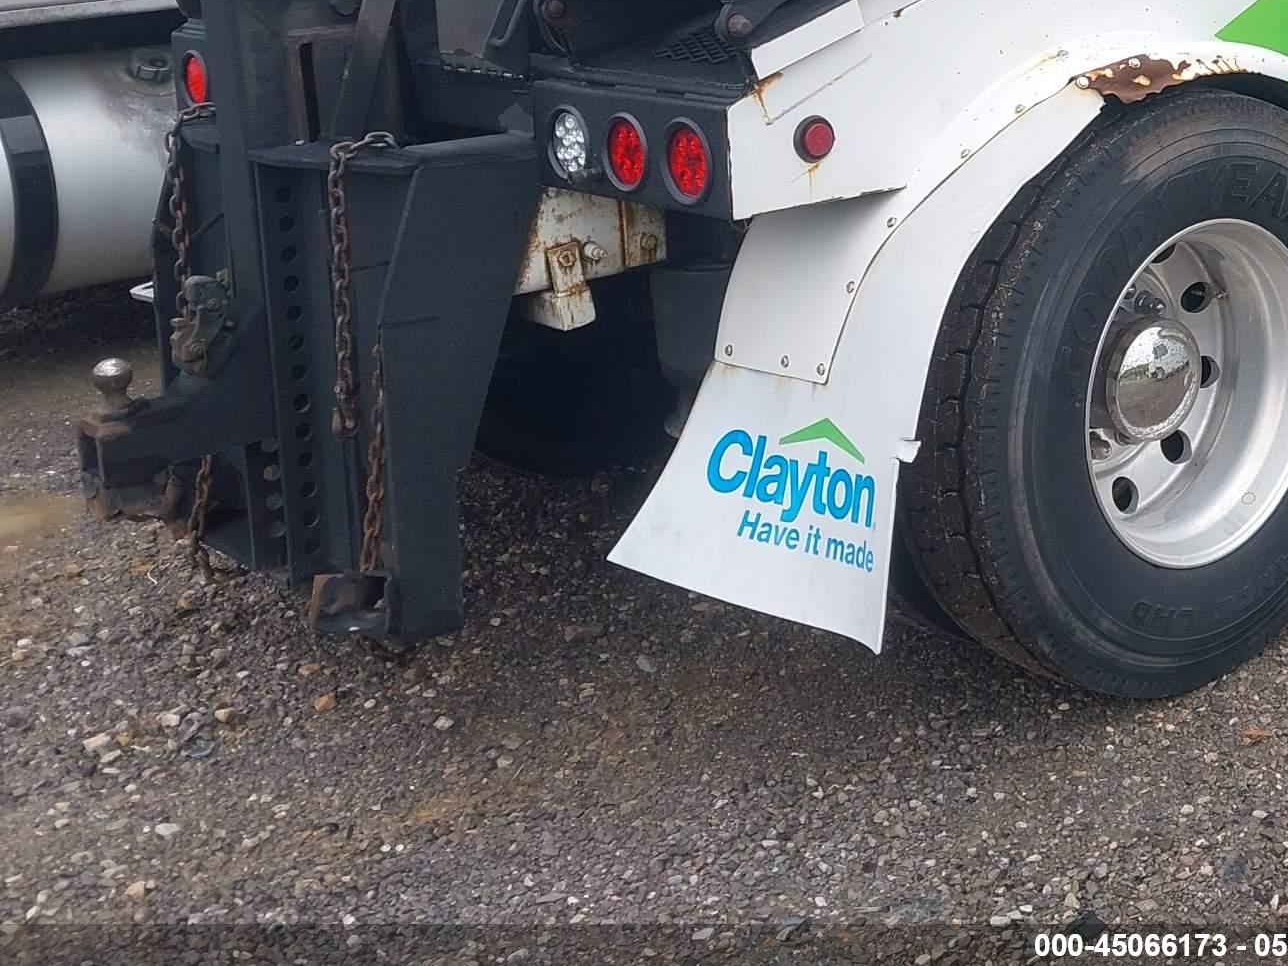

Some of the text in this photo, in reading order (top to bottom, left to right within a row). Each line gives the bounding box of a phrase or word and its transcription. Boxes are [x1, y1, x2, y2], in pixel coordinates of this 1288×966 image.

[707, 429, 876, 528] Clayton
[736, 510, 874, 573] Have it made
